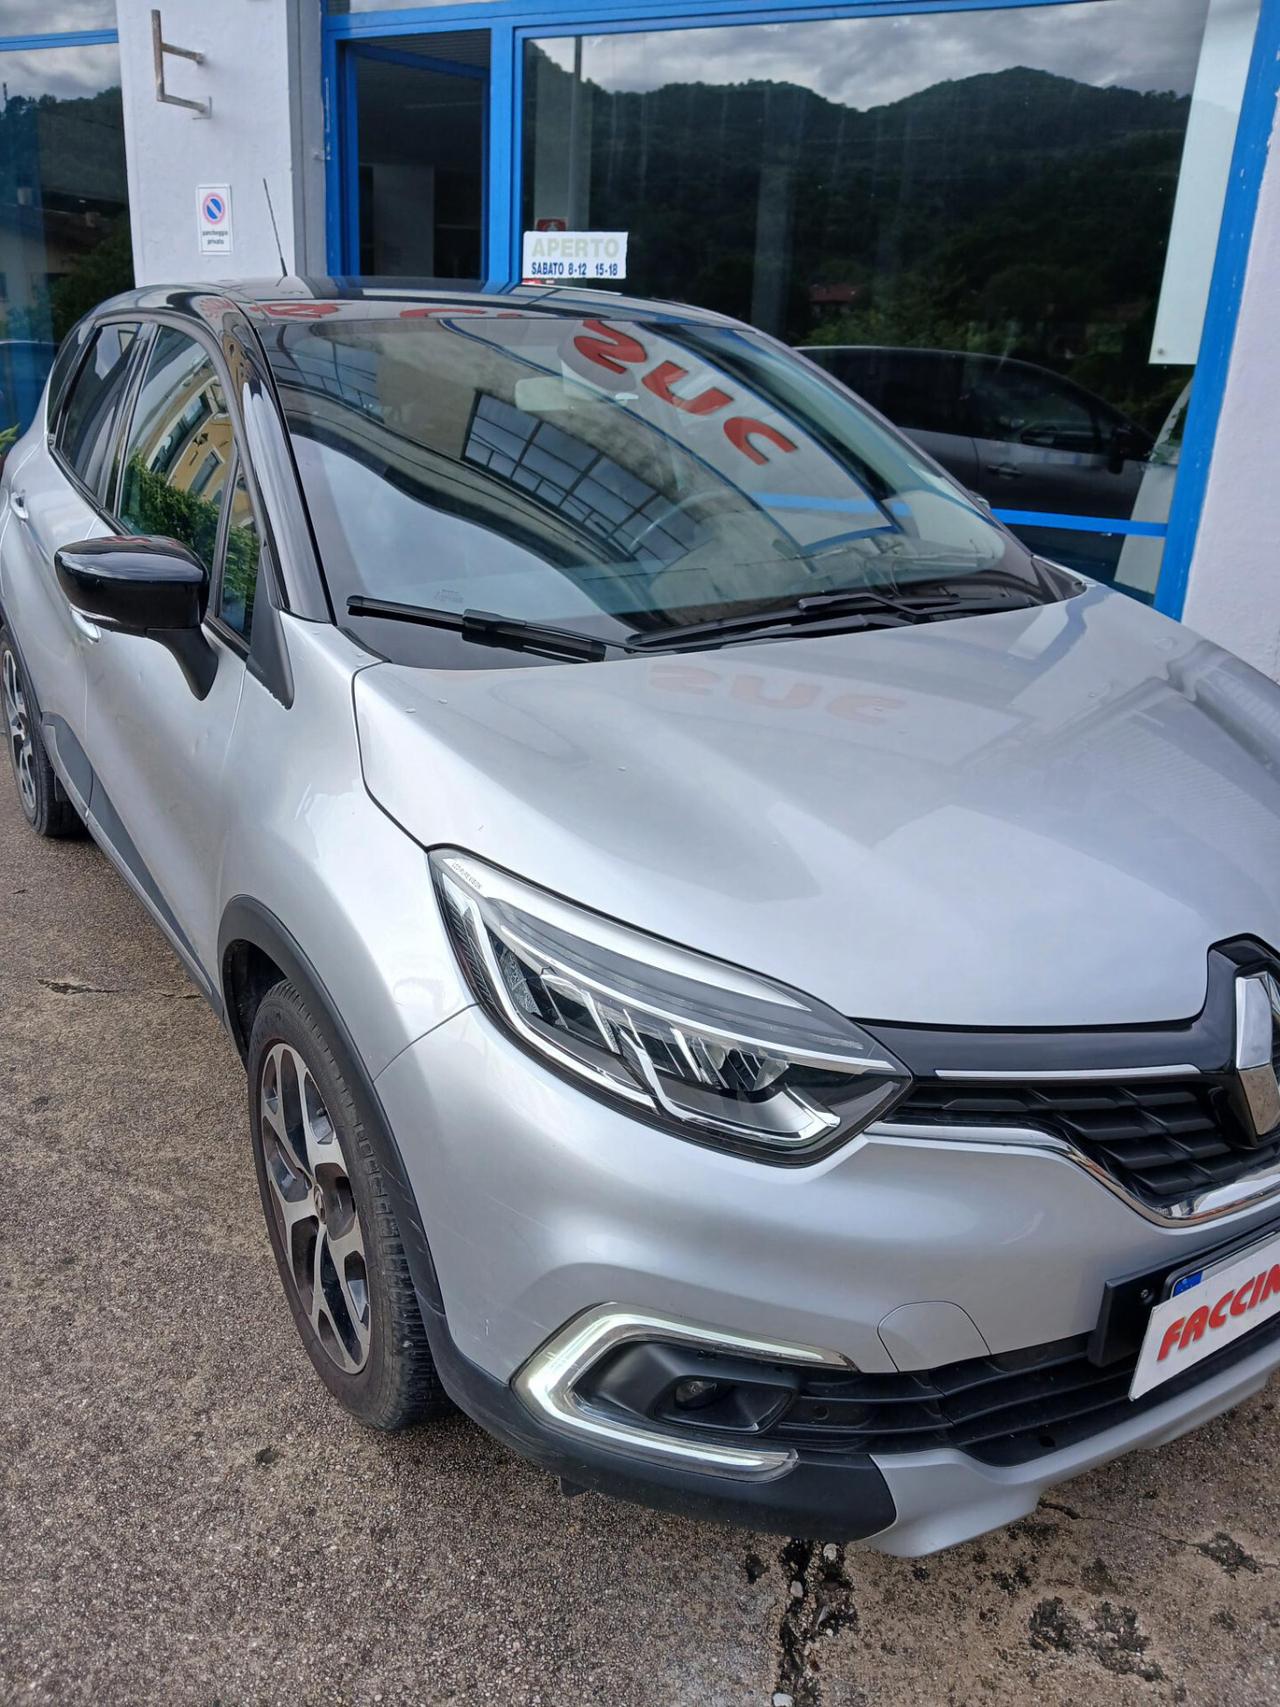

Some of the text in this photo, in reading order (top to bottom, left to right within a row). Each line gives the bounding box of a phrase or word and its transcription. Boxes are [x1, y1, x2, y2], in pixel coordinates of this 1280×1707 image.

[532, 238, 619, 258] APERTO
[531, 262, 618, 276] SABATO 8-12 15-18
